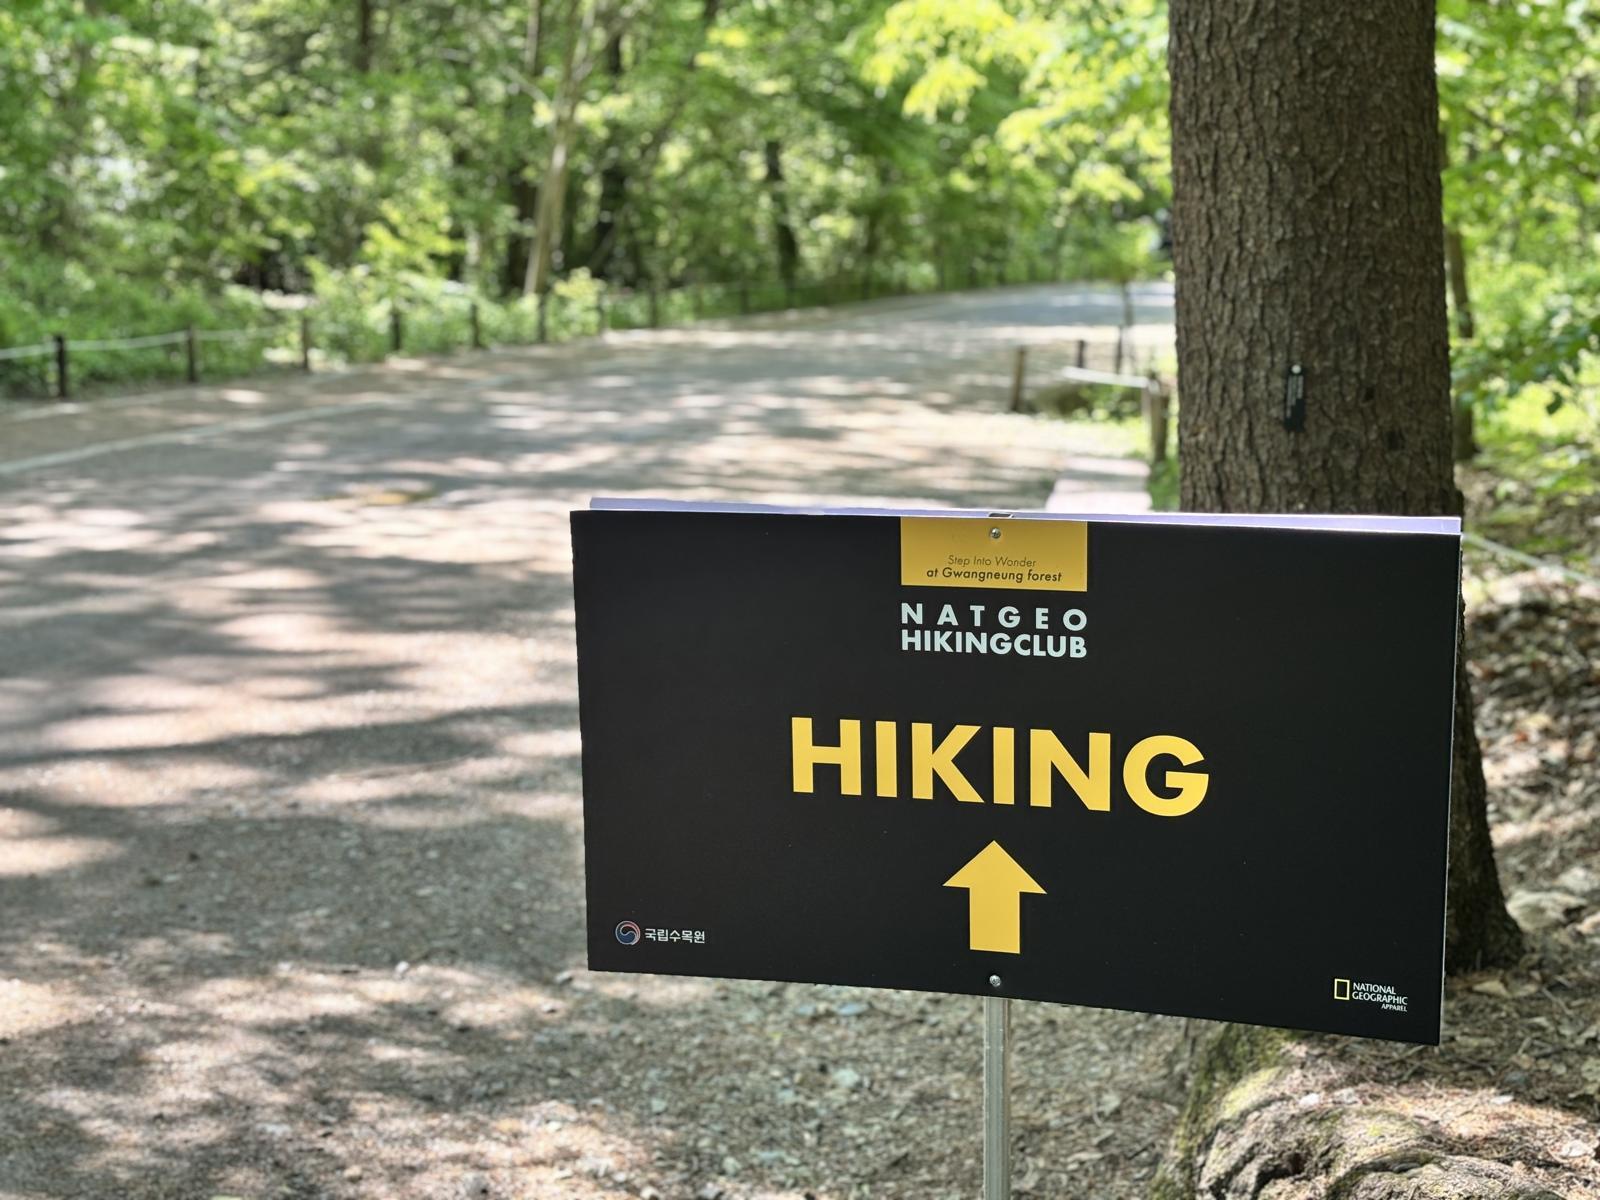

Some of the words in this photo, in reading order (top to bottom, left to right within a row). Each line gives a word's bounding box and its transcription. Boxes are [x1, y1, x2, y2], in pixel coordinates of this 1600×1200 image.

[948, 555, 970, 567] Step
[973, 555, 991, 566] Into
[995, 556, 1036, 568] Wonder
[926, 568, 938, 578] at
[942, 567, 1023, 583] Gwangneung
[1027, 569, 1062, 582] forest
[901, 629, 1088, 659] HIKINGCLUB
[792, 716, 1210, 818] HIKING
[645, 928, 705, 944] 국립수목원
[1353, 982, 1396, 995] NATIONAL
[1352, 991, 1408, 1005] GEOGRAPHIC
[1381, 1003, 1407, 1012] APPAREL
